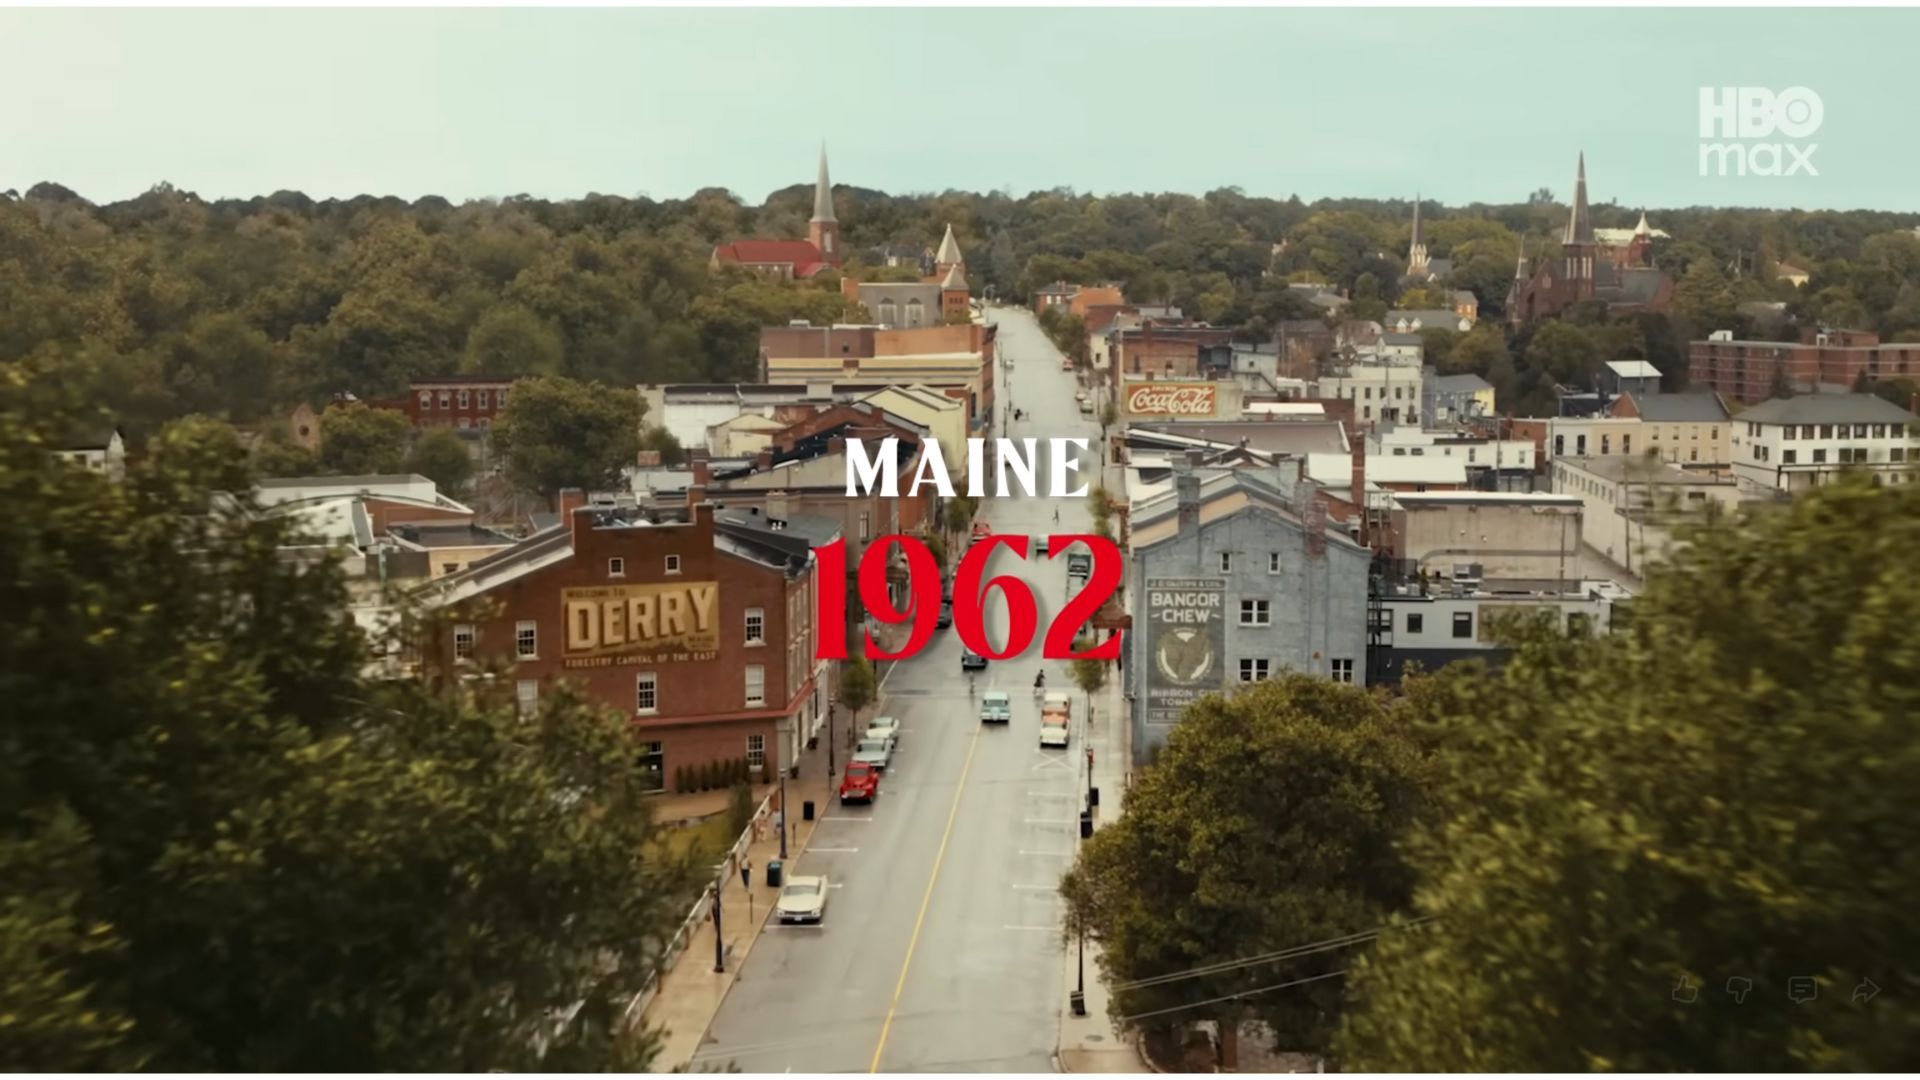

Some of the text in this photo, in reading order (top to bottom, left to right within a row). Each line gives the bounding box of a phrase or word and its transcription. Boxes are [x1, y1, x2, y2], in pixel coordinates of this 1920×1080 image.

[1151, 592, 1220, 607] BANGOR
[565, 587, 715, 651] DERRY
[565, 651, 716, 668] FORESTRY CAPITAL OF THE EAST
